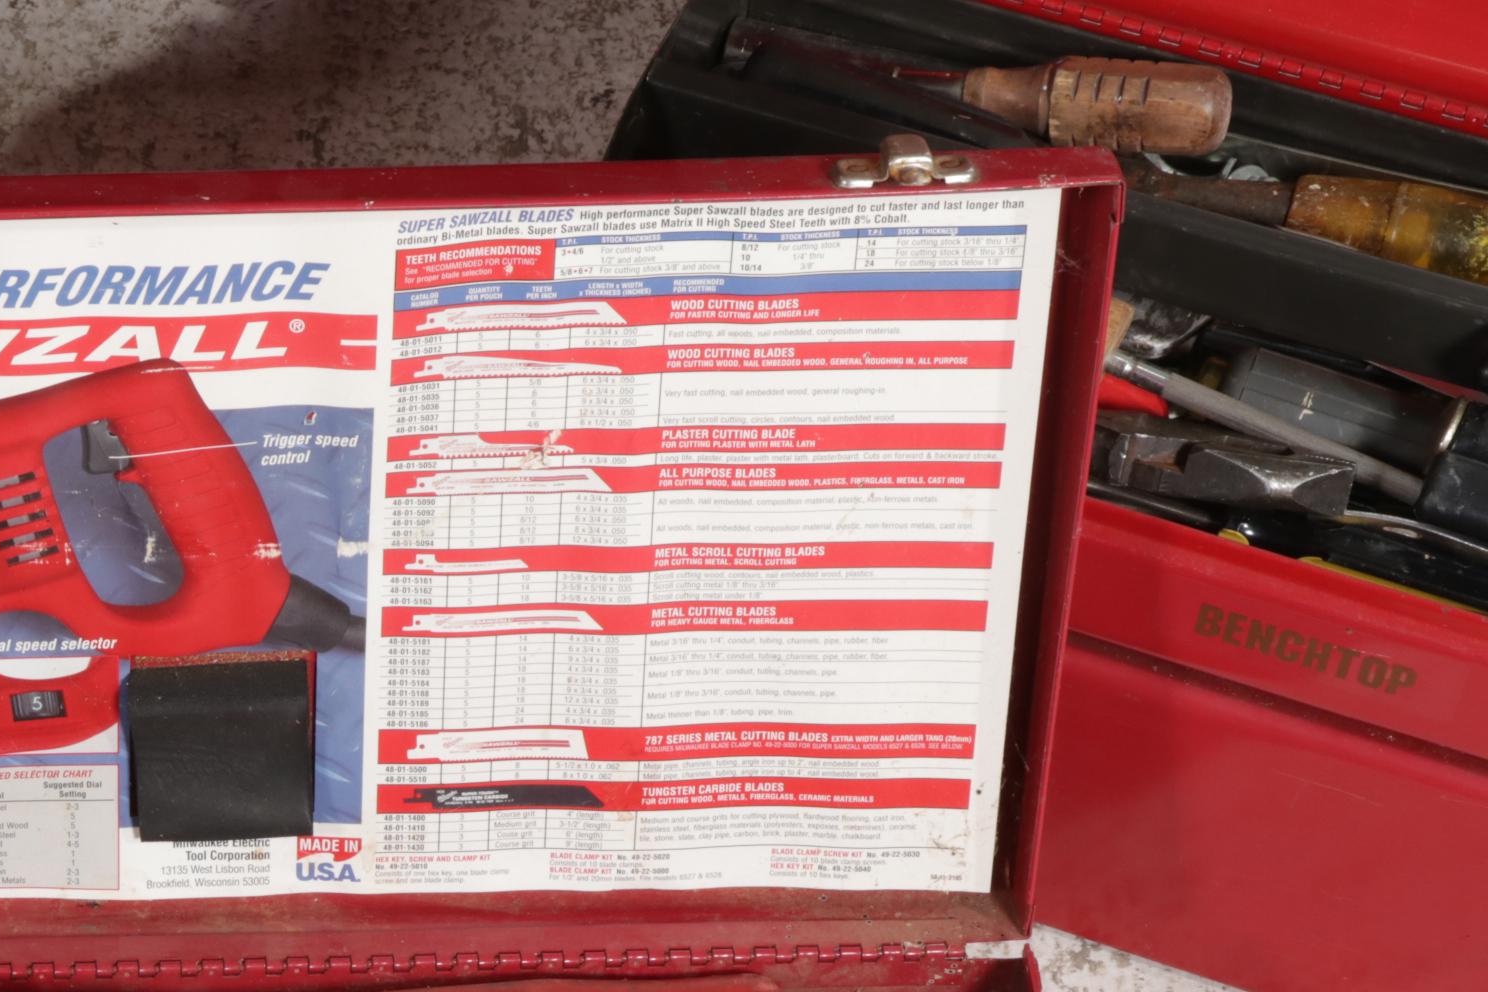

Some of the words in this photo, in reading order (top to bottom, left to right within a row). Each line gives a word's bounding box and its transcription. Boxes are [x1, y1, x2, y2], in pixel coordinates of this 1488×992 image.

[579, 210, 603, 221] High
[606, 208, 670, 220] performance
[673, 205, 704, 216] Super
[706, 204, 746, 215] Sawzall
[749, 206, 784, 216] blades
[787, 208, 804, 216] are
[807, 204, 854, 216] designed
[856, 204, 867, 213] to
[869, 203, 886, 213] cut
[888, 202, 918, 212] faster
[920, 200, 940, 210] and
[943, 200, 962, 210] last
[965, 200, 999, 211] longer
[1002, 199, 1024, 209] than
[398, 217, 446, 233] SUPER
[449, 211, 513, 228] SAWZALL
[518, 208, 575, 223] BLADES
[396, 235, 438, 245] ordinary
[441, 230, 485, 243] Bi-Metal
[486, 227, 524, 237] blades.
[527, 225, 558, 237] Super
[560, 221, 599, 234] Sawzall
[602, 221, 636, 231] blades
[639, 221, 657, 229] use
[660, 217, 693, 228] Matrix
[696, 217, 703, 227] II
[706, 217, 730, 229] High
[733, 217, 766, 229] Speed
[768, 215, 796, 229] Steel
[799, 217, 826, 227] Teeth
[828, 214, 850, 226] with
[873, 214, 909, 225] Cobalt.
[405, 254, 437, 265] TEETH
[439, 246, 542, 259] RECOMMENDATIONS
[670, 299, 704, 310] WOOD
[707, 299, 754, 310] CUTTING
[757, 298, 799, 310] BLADES
[662, 429, 709, 439] PLASTER
[712, 429, 758, 439] CUTTING
[761, 428, 795, 439] BLADE
[262, 433, 312, 450] Trigger
[314, 434, 360, 450] speed
[260, 450, 310, 466] control
[659, 468, 678, 478] ALL
[682, 467, 731, 477] PURPOSE
[734, 468, 776, 478] BLADES
[14, 640, 58, 655] speed
[59, 636, 118, 651] selector
[1193, 602, 1418, 696] BENCHTOP
[31, 696, 43, 711] 5
[13, 769, 60, 779] SELECTOR
[62, 769, 93, 778] CHART
[43, 781, 84, 791] Suggested
[85, 780, 103, 788] Dial
[642, 785, 695, 796] TUNGSTEN
[698, 783, 743, 794] CARBIDE
[744, 783, 784, 793] BLADES
[58, 790, 87, 799] Setting
[299, 838, 339, 853] MADE
[344, 837, 360, 853] IN
[185, 850, 207, 861] Tool
[210, 850, 270, 862] Corporation
[161, 864, 188, 875] 13135
[190, 864, 212, 874] West
[215, 864, 244, 873] Lisbon
[247, 863, 270, 873] Road
[296, 862, 360, 882] U.S.A.
[194, 878, 240, 887] Wisconsin
[241, 876, 271, 886] 53005
